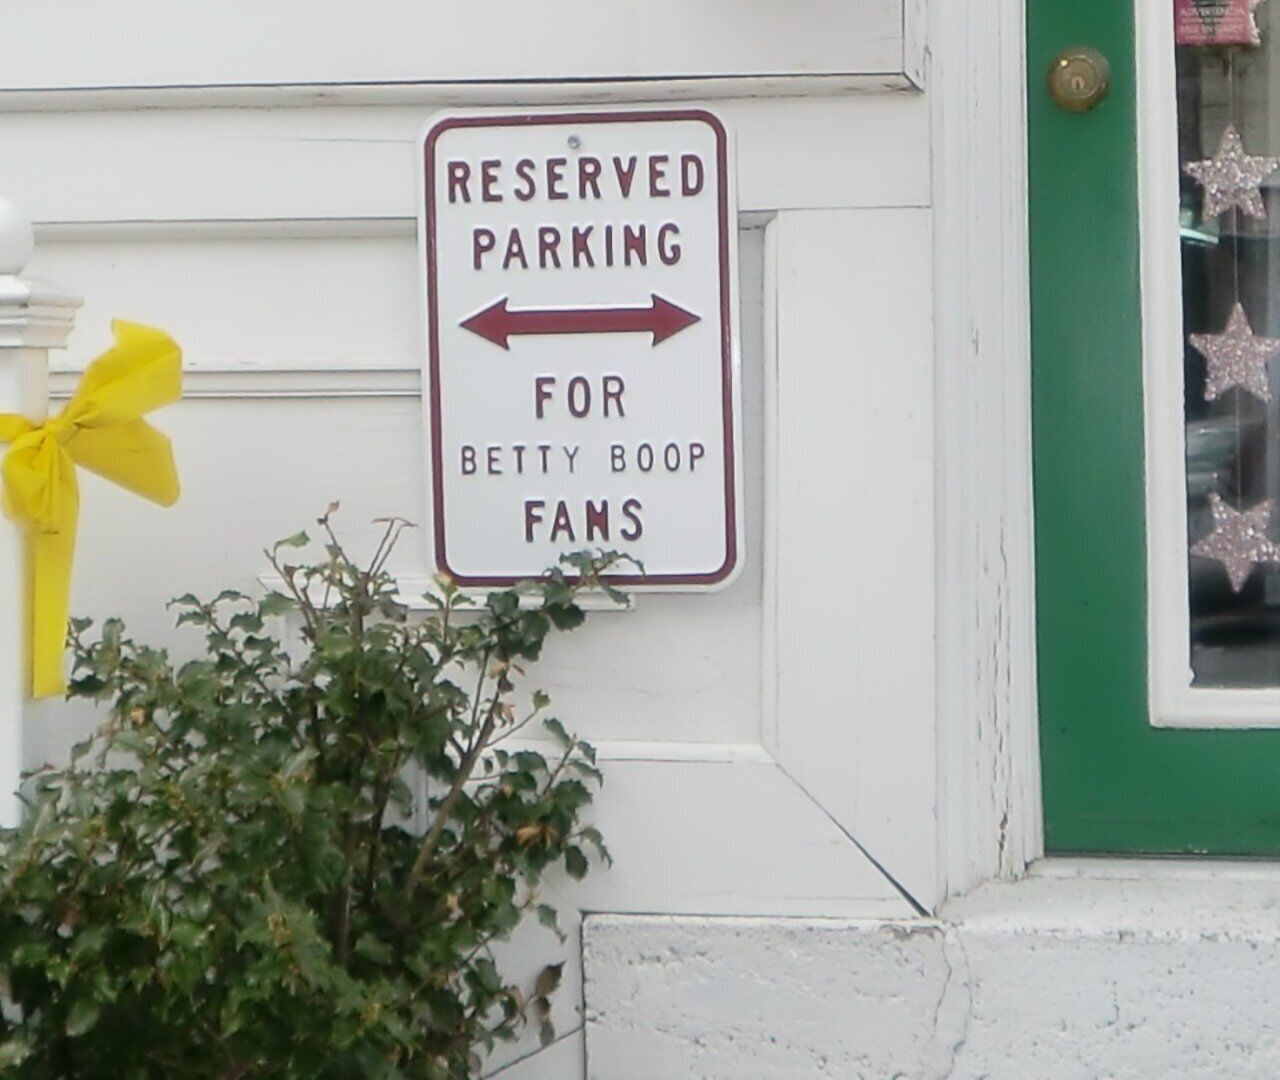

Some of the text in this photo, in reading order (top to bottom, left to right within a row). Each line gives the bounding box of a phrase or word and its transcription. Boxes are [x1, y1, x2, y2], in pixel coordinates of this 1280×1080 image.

[446, 153, 705, 204] RESERVED
[472, 222, 683, 271] PARKING
[534, 374, 626, 420] FOR
[460, 441, 707, 476] BETTY BOOP
[523, 497, 645, 544] FANS
